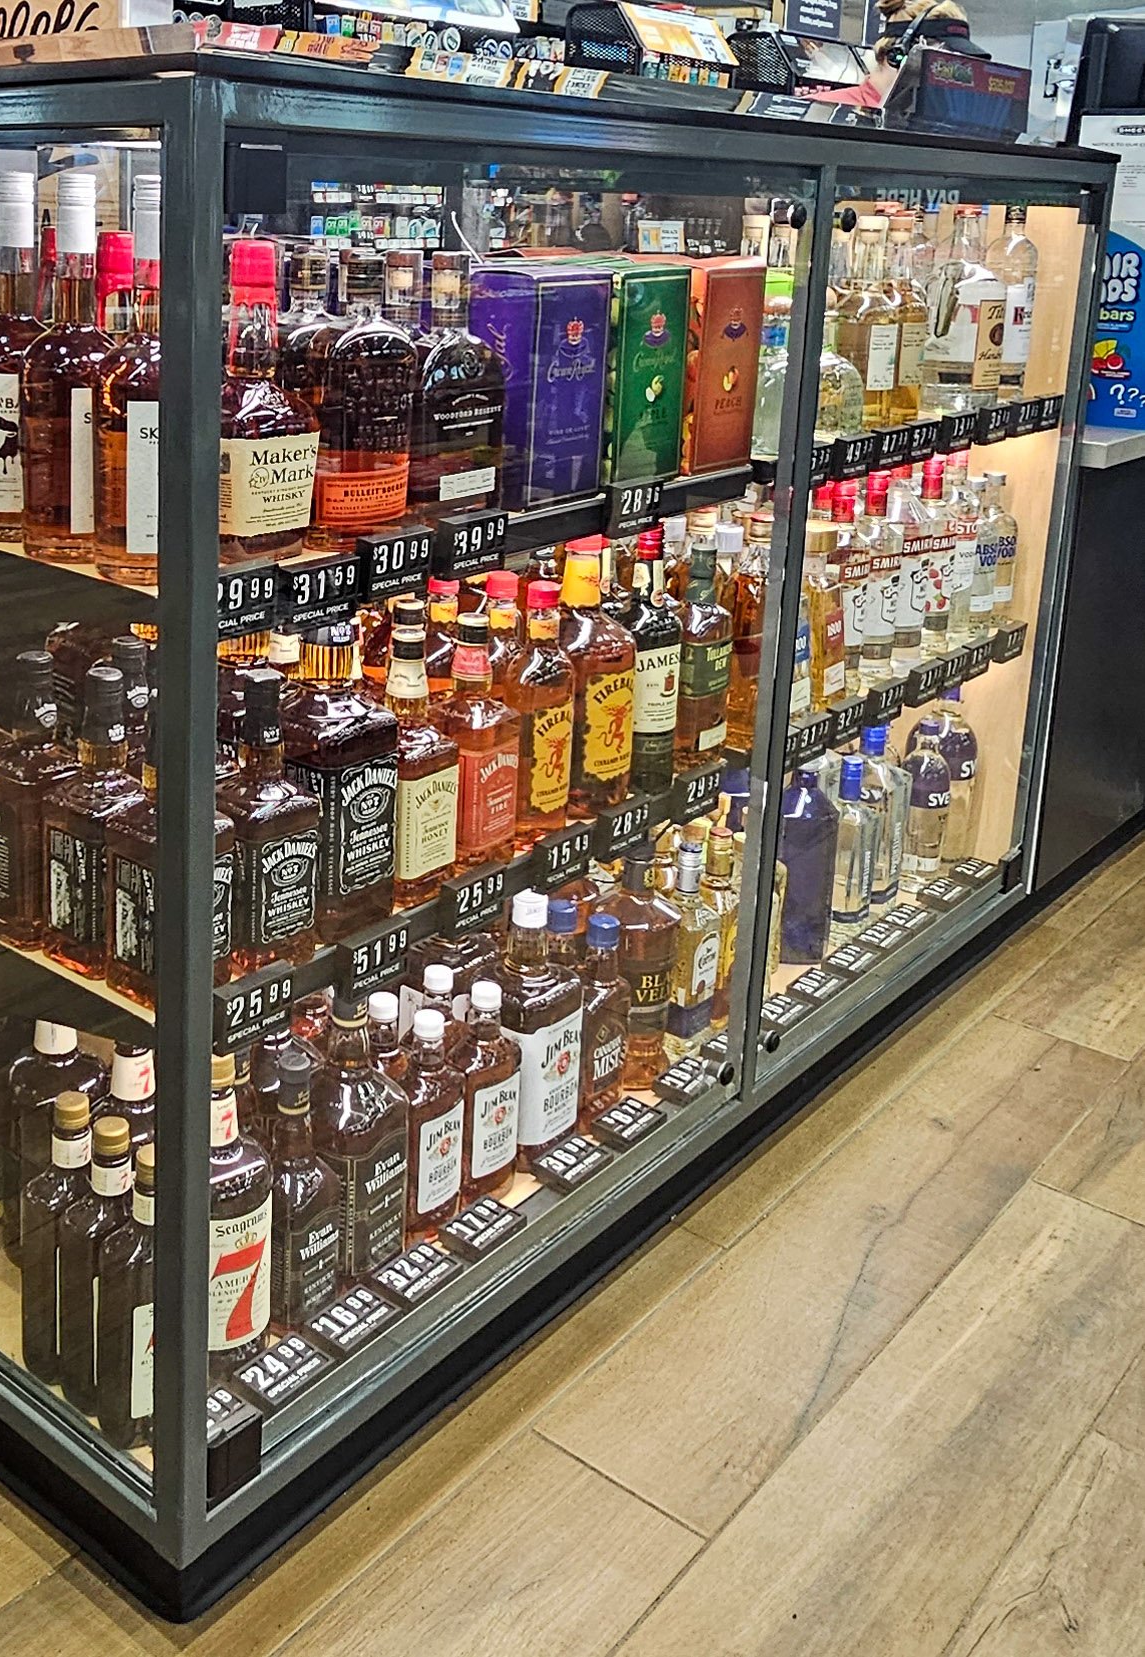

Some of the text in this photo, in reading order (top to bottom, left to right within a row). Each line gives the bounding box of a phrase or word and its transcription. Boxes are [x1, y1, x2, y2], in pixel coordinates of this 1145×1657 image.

[1099, 308, 1134, 321] bars
[433, 410, 473, 421] WOODFORD
[249, 444, 317, 466] Maker's
[270, 464, 314, 486] Mark
[262, 490, 306, 503] WHISKY
[343, 486, 378, 498] BULLEIT
[454, 552, 500, 571] SPECIAL PRICE
[372, 573, 423, 591] SPECIAL PRICE
[218, 611, 266, 629] CIAL PRICE
[292, 602, 349, 623] SPECIAL PRICE
[480, 759, 498, 784] JACK
[340, 774, 365, 807] JACK
[415, 786, 433, 810] JACK
[490, 799, 508, 814] FIRE
[349, 823, 389, 845] Tennessee
[421, 828, 449, 845] HONEY
[261, 848, 285, 874] JACK
[346, 836, 391, 862] WHISKEY
[267, 896, 310, 917] WHISKEY
[481, 905, 498, 920] PRICE
[380, 962, 400, 979] PRICE
[227, 1010, 286, 1043] SPECIAL PRICE
[540, 1029, 581, 1069] JIM BEA
[592, 1047, 622, 1081] MIST
[480, 1089, 517, 1119] JIM BEAM
[218, 1115, 234, 1140] 7
[426, 1118, 462, 1151] JIM BEAM
[483, 1127, 513, 1150] BOURBON
[364, 1158, 408, 1195] Williams
[374, 1152, 401, 1177] Evan
[428, 1158, 458, 1183] BOURBON
[215, 1208, 268, 1239] Seagram's
[308, 1222, 334, 1246] Evan
[491, 1212, 514, 1233] PRICE
[299, 1228, 340, 1261] Williams
[209, 1233, 268, 1342] 7
[403, 1261, 451, 1300] SPECIAL PRICE
[338, 1305, 389, 1346] SPECIAL PRICE
[267, 1356, 322, 1399] SPECIAL PRICE
